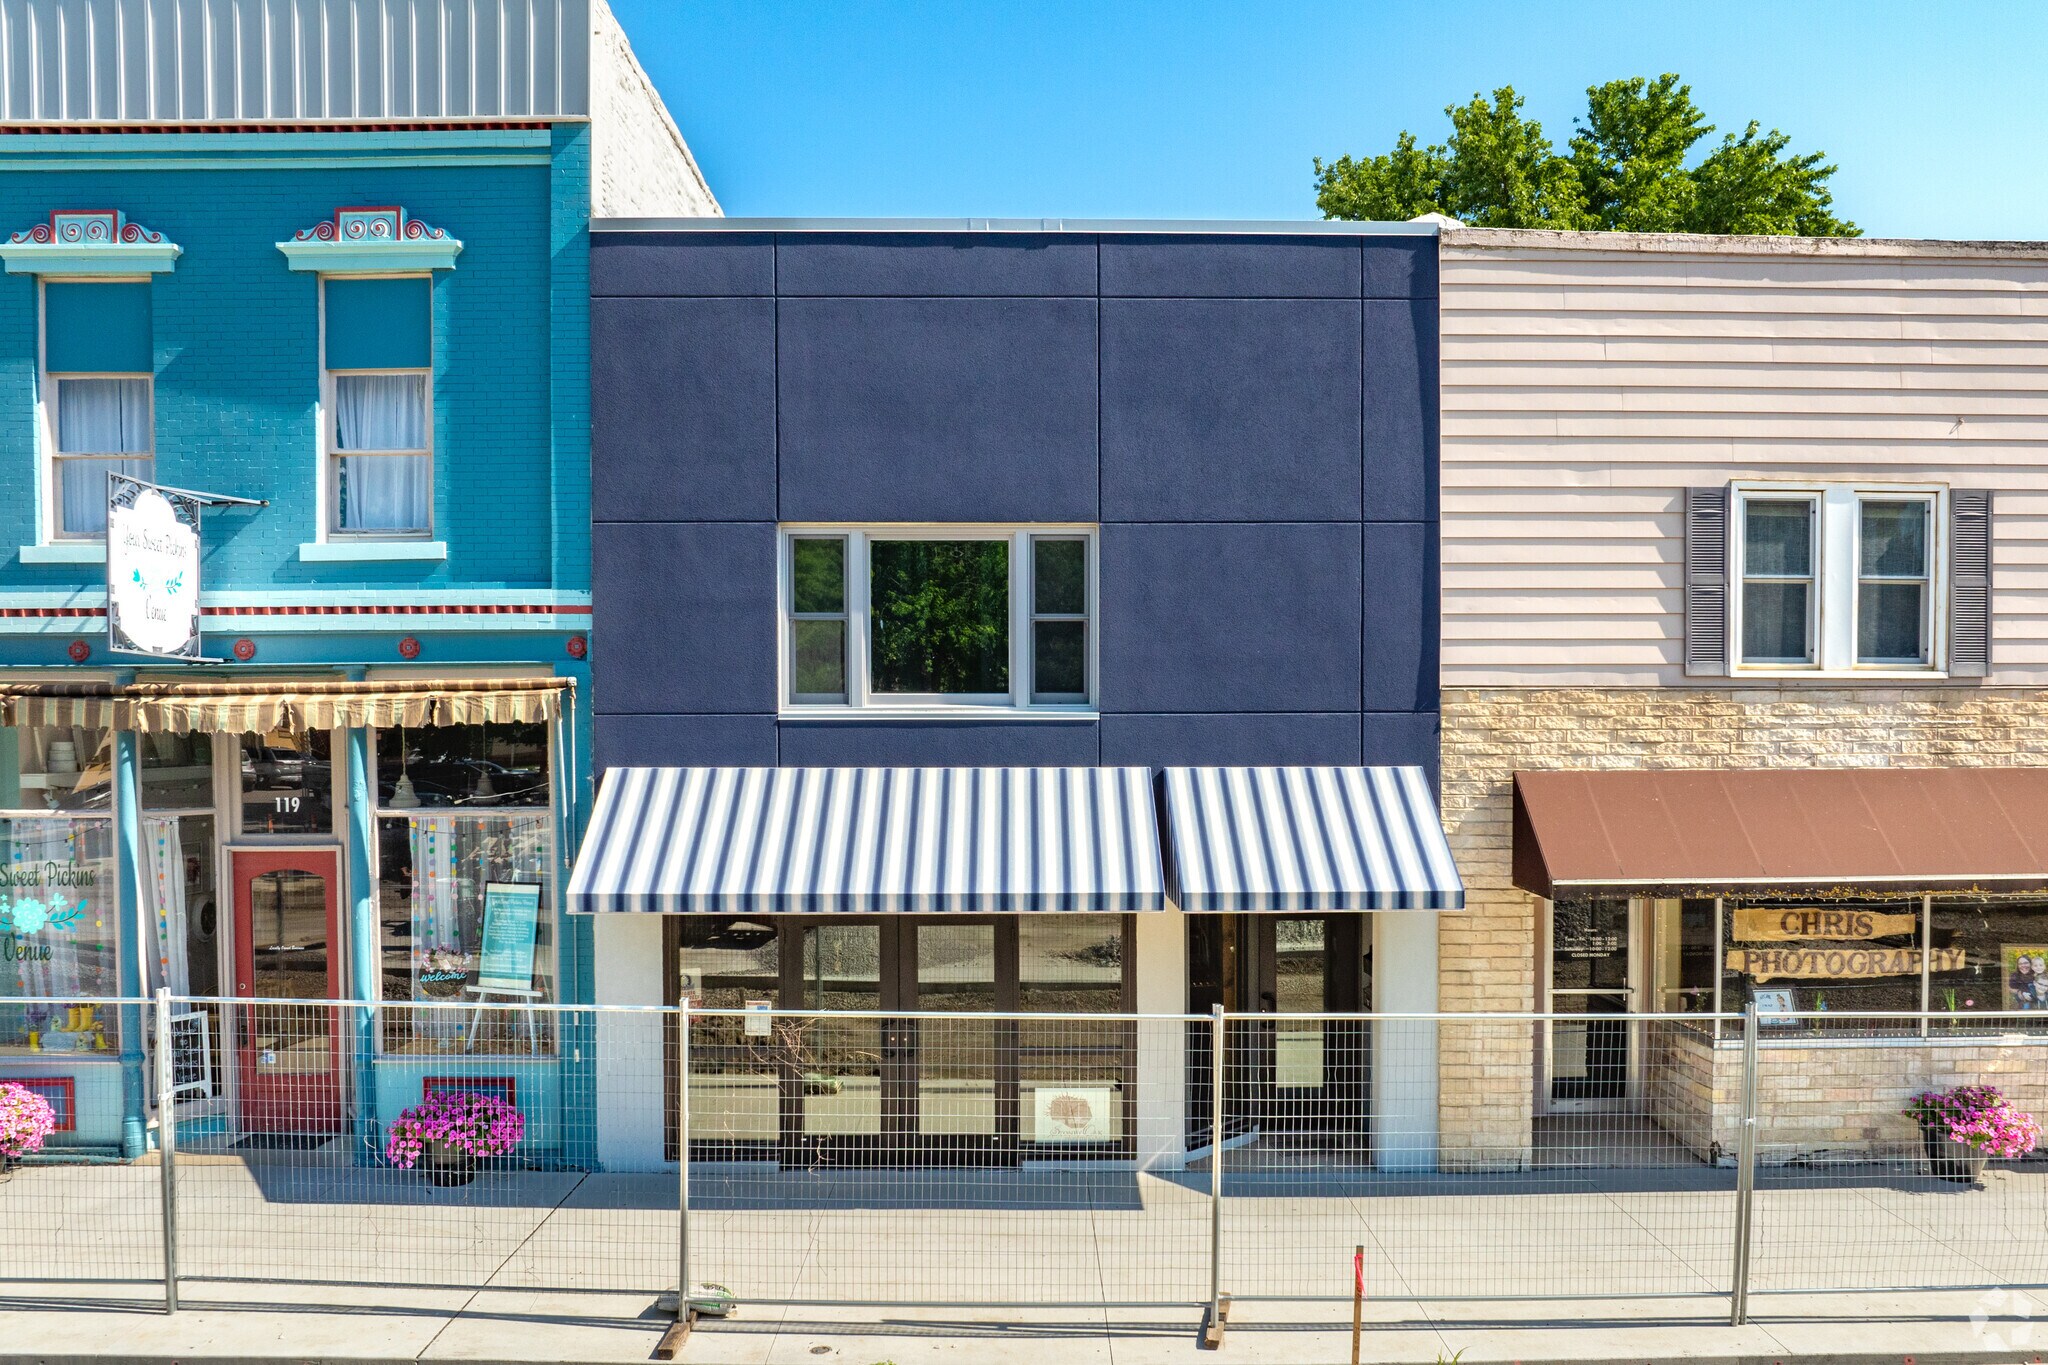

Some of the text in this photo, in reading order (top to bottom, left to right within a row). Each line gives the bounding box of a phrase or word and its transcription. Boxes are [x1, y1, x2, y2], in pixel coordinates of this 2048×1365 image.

[275, 797, 300, 813] 119
[0, 859, 97, 889] Sweet Pickins
[1780, 911, 1874, 937] CHRIS
[4, 931, 54, 962] Venue
[1743, 949, 1965, 976] PHOTOGRAPHY
[419, 970, 468, 983] welcome
